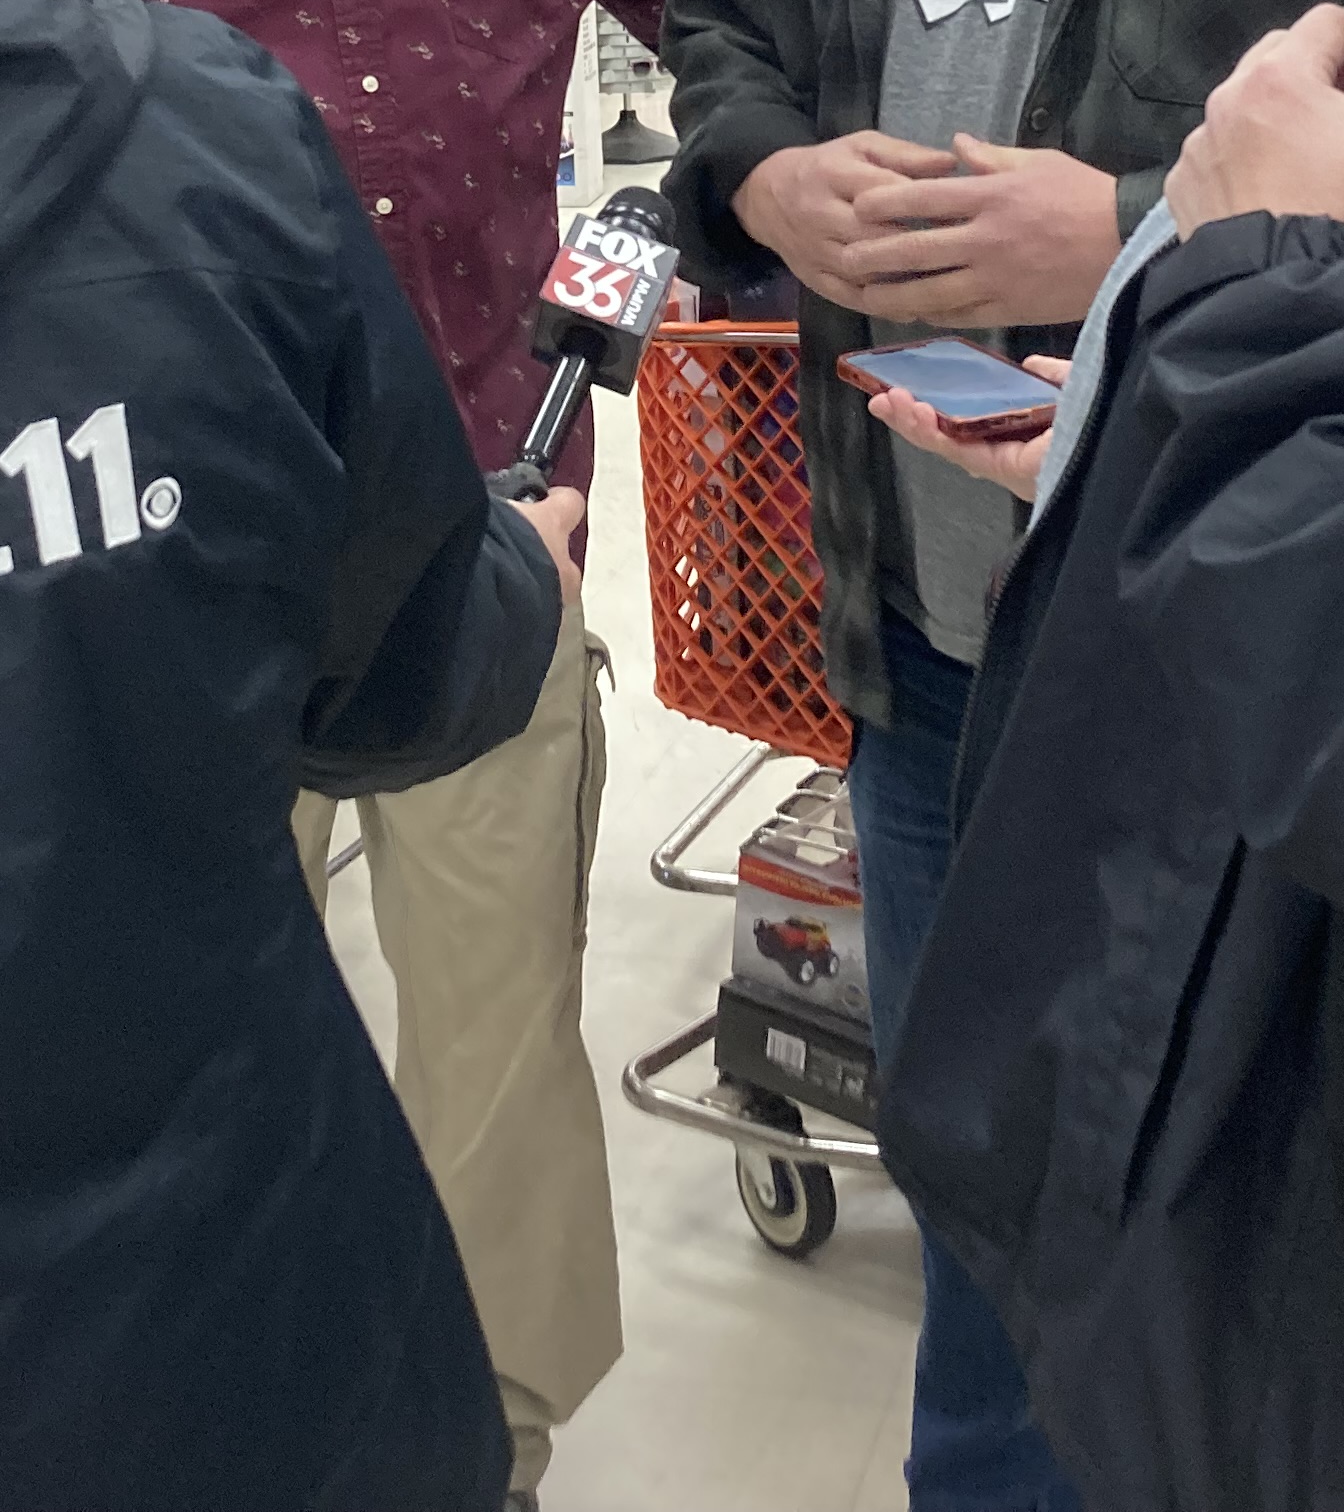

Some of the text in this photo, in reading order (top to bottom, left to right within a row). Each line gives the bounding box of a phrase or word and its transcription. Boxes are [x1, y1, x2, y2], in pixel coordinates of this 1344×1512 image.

[575, 219, 666, 278] FOX
[554, 251, 651, 326] 36 WUPW
